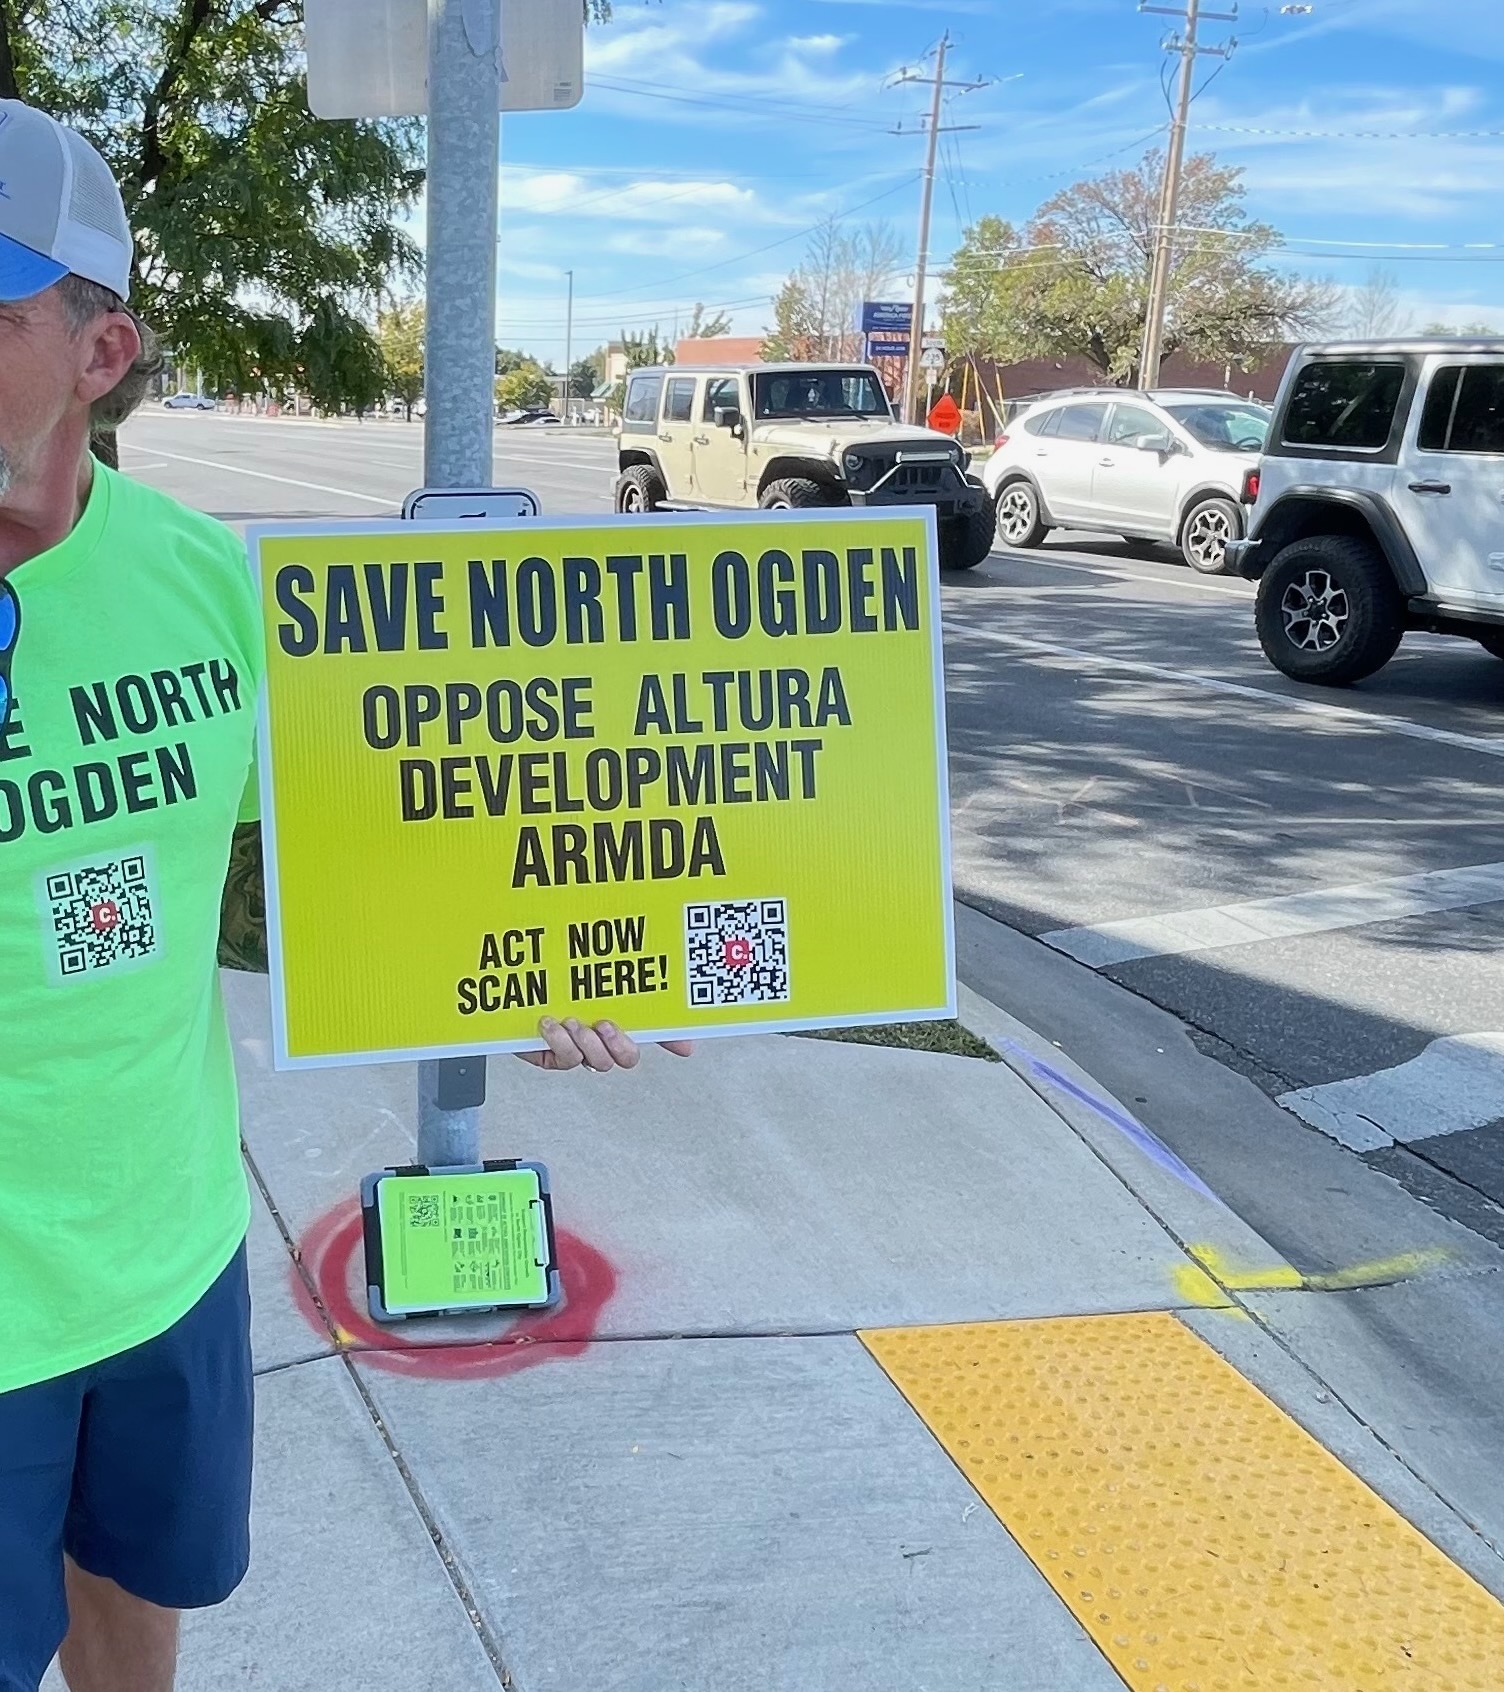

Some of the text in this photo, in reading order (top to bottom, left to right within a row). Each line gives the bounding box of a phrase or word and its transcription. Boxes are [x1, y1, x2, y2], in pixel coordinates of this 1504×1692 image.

[275, 547, 920, 657] SAVE NORTH OGDEN
[69, 658, 242, 747] NORTH
[363, 666, 852, 749] OPPOSE ALTURA
[400, 739, 823, 822] DEVELOPMENT
[511, 817, 726, 889] ARMDA
[457, 955, 669, 1015] SCAN HERE!
[479, 917, 646, 970] ACT NOW
